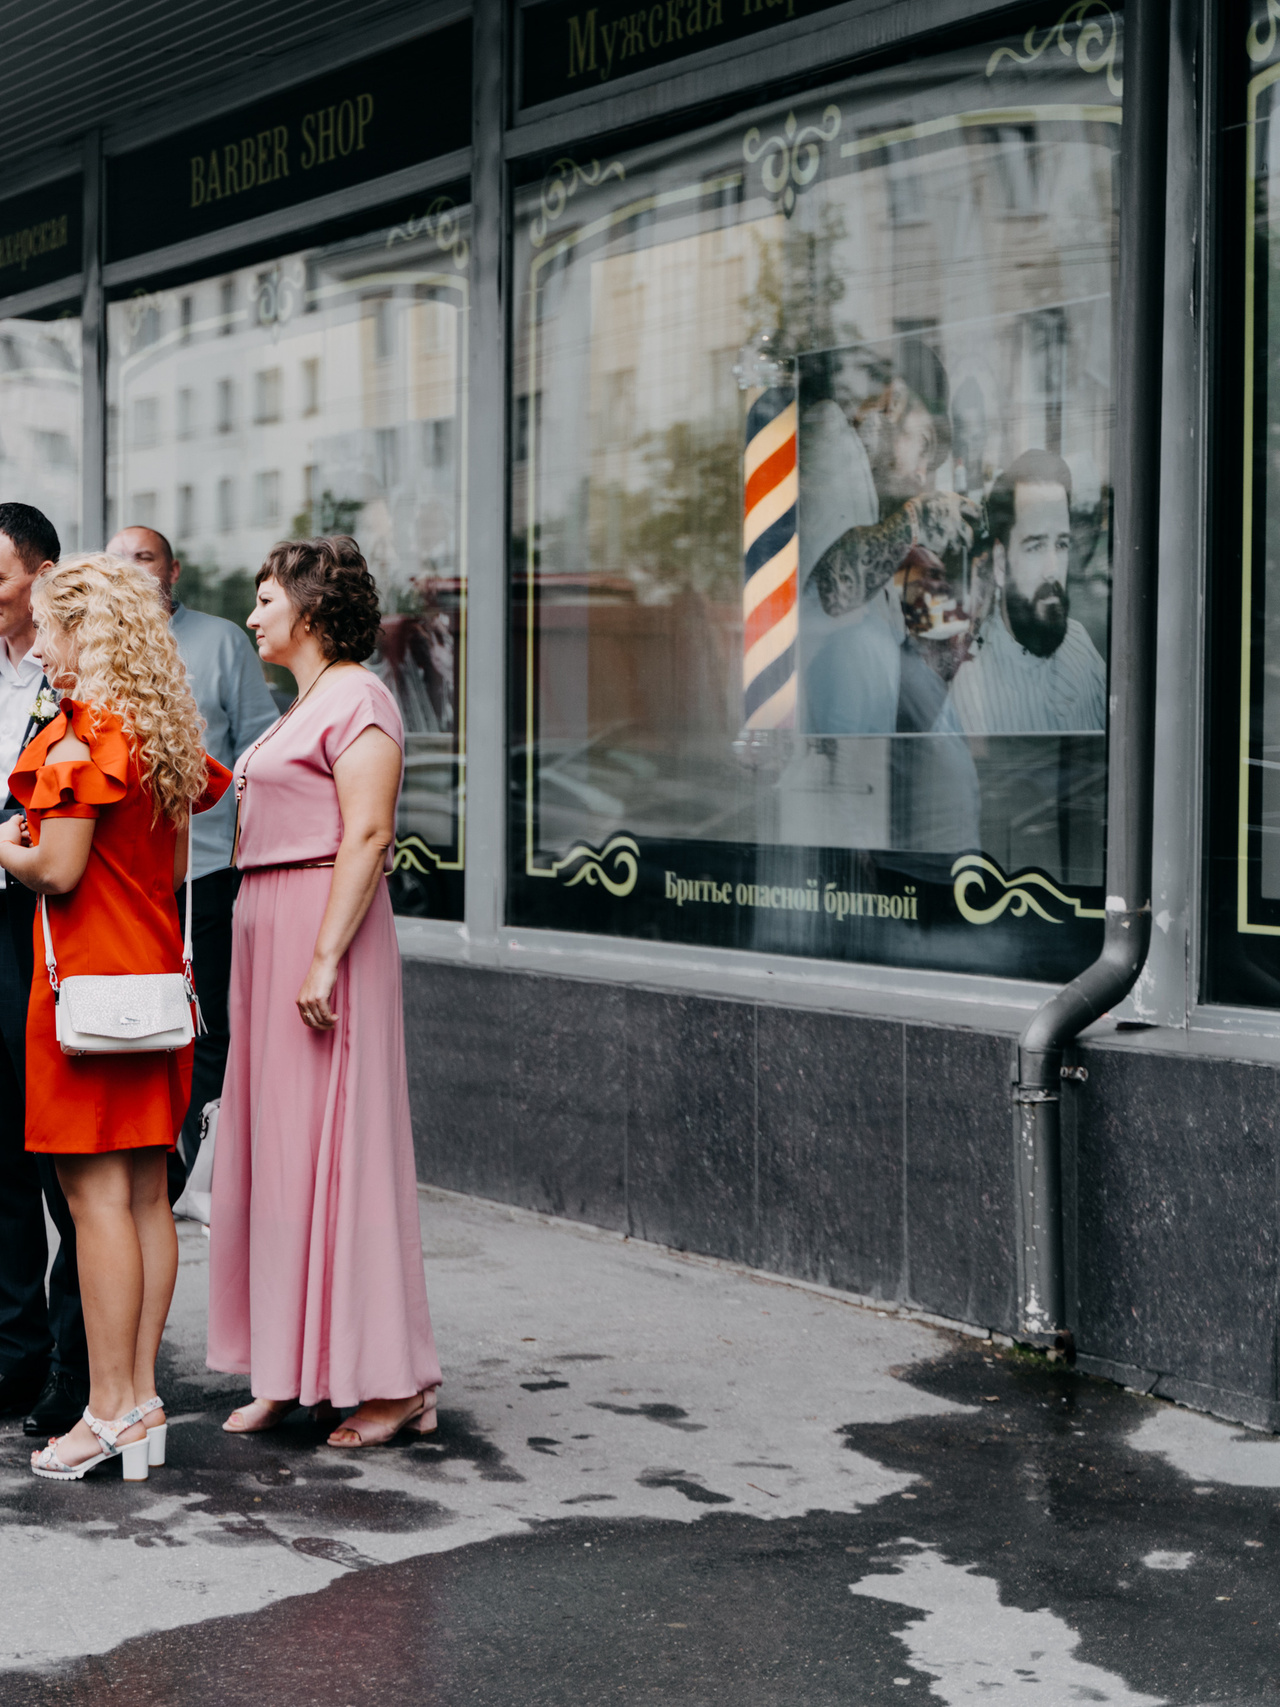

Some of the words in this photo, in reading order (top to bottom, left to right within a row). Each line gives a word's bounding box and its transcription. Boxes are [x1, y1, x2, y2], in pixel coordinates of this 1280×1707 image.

[566, 0, 725, 81] Мужская
[190, 125, 290, 208] BARBER
[300, 93, 374, 170] SHOP
[665, 870, 732, 907] Бритье
[735, 878, 820, 913] опасной
[824, 881, 918, 921] бритвой
